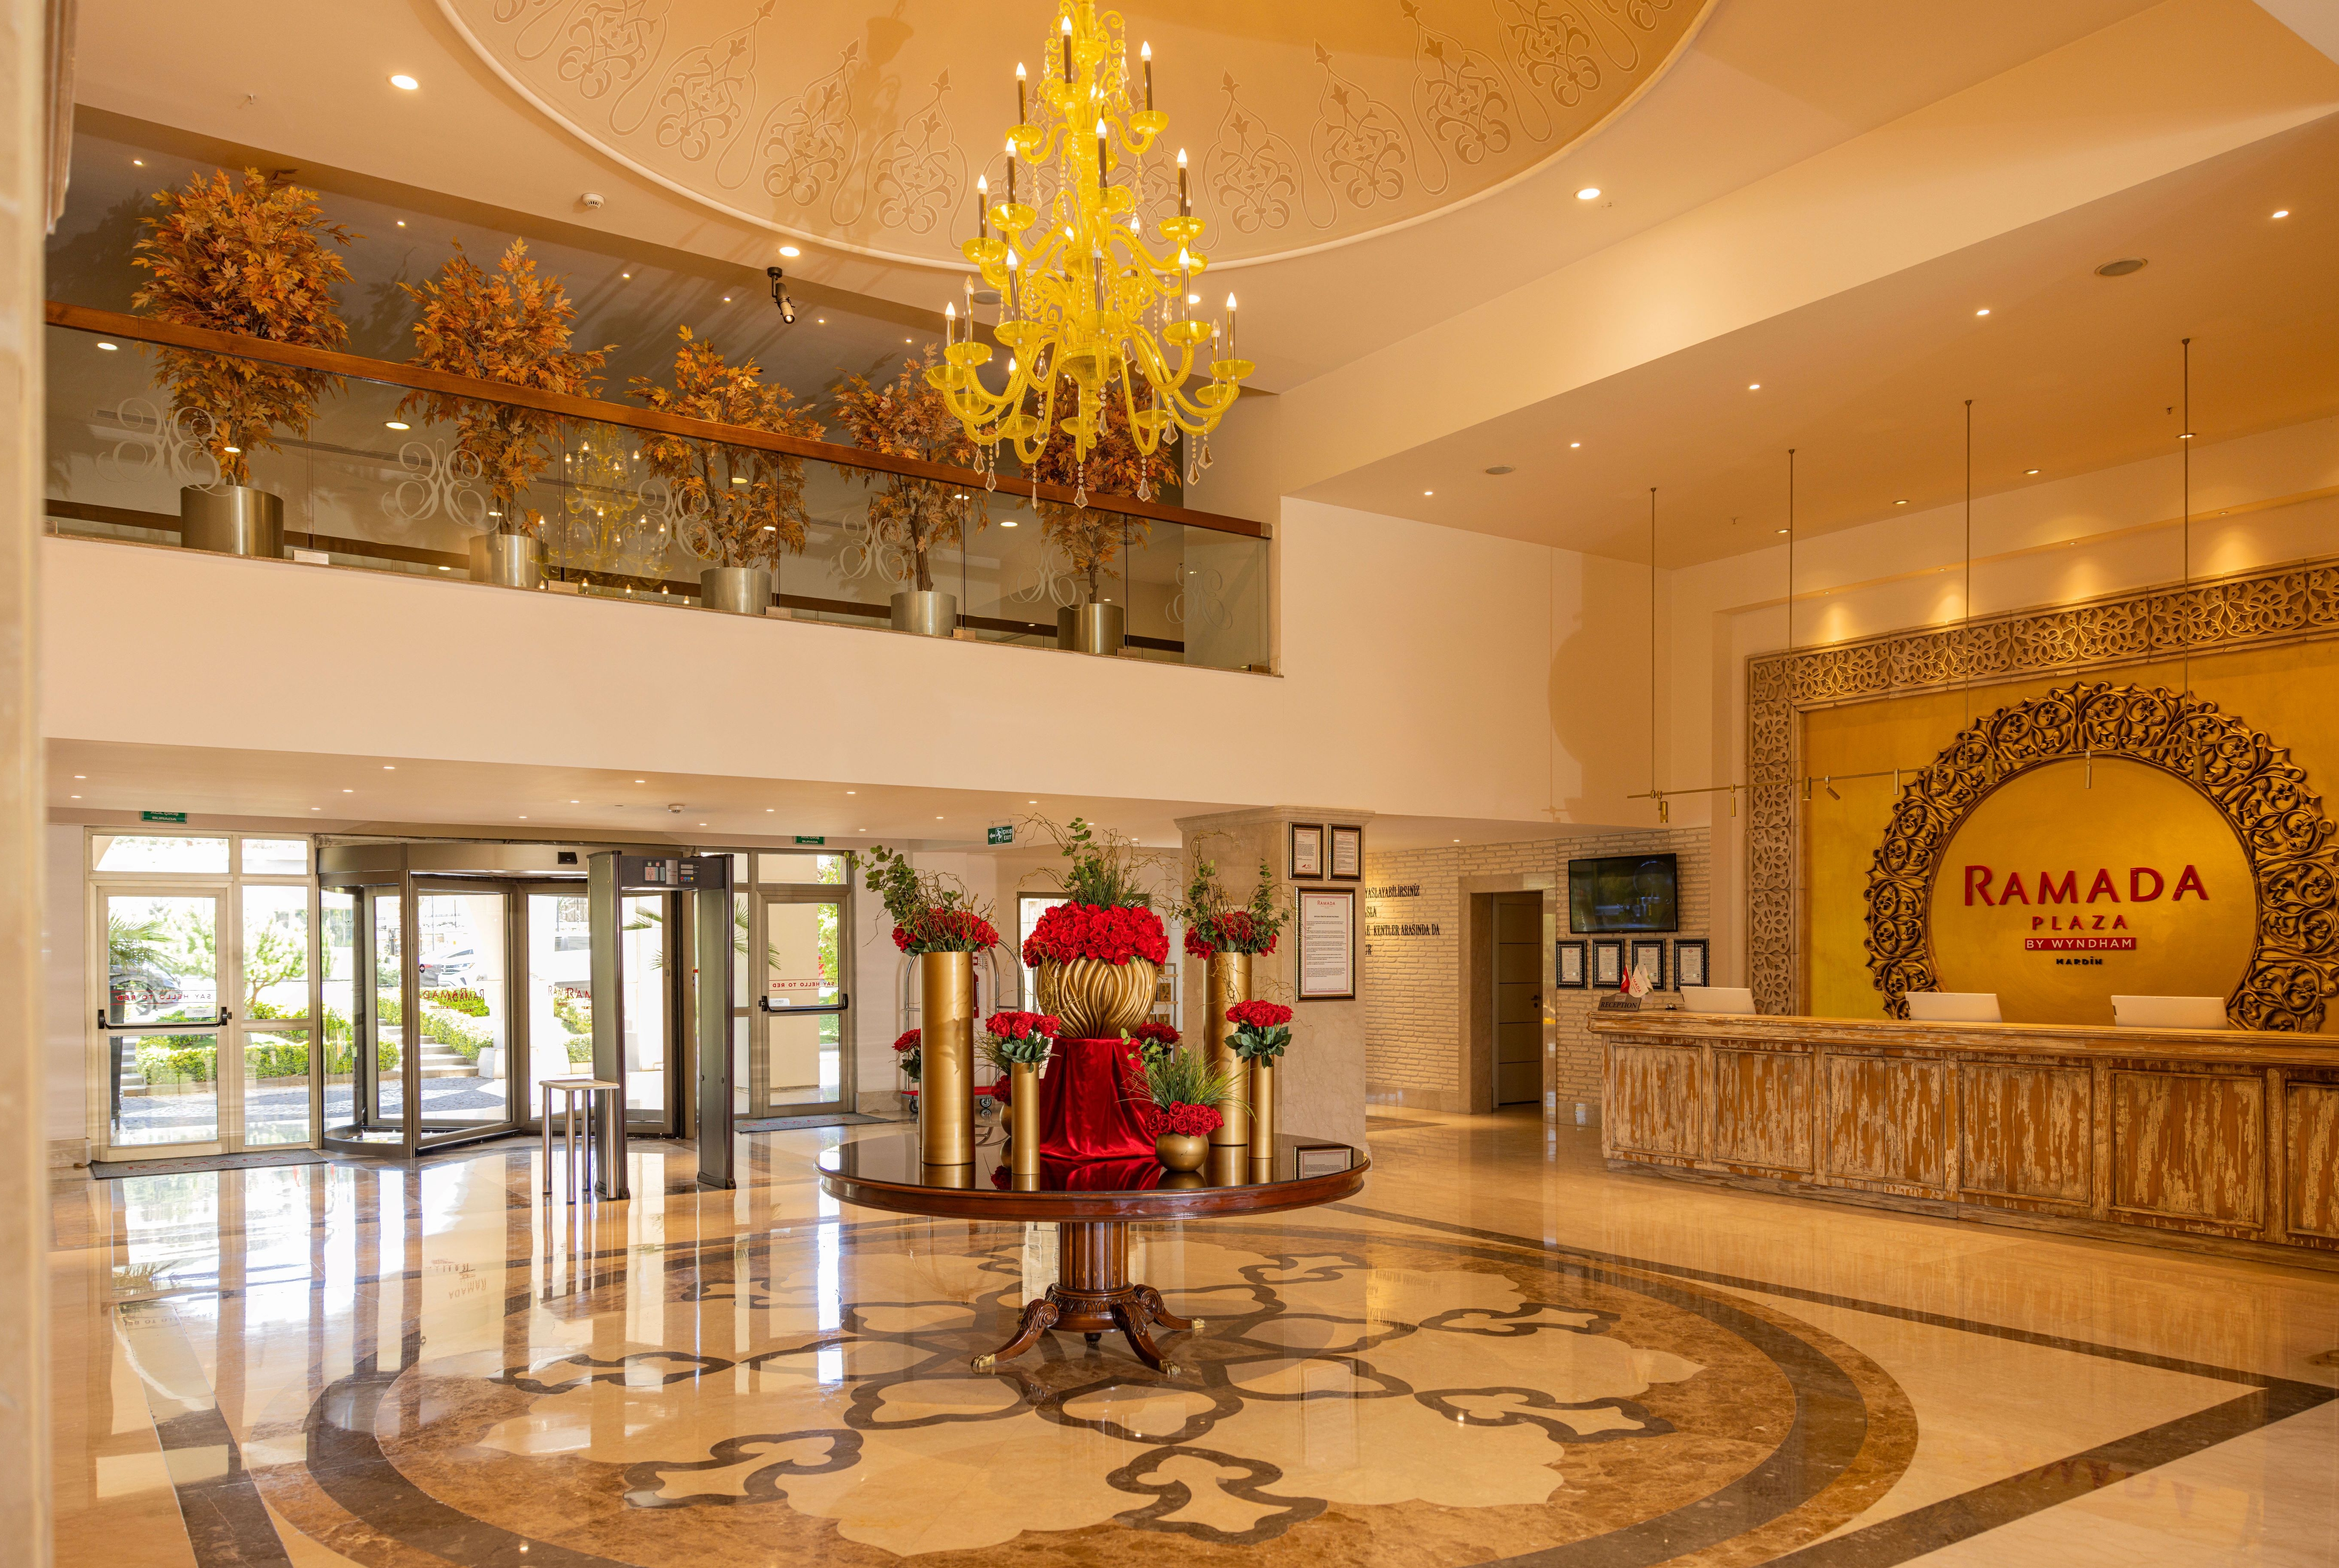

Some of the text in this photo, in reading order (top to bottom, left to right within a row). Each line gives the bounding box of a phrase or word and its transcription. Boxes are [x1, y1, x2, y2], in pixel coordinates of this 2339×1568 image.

[1964, 864, 2209, 906] RAMADA
[1374, 925, 1399, 936] KENTLER
[1401, 924, 1430, 935] ARASINDA
[1431, 924, 1440, 935] DA
[2032, 914, 2128, 931] PLAZA
[2027, 939, 2132, 949] BY WYNDHAM
[1632, 976, 1642, 993] AMADA
